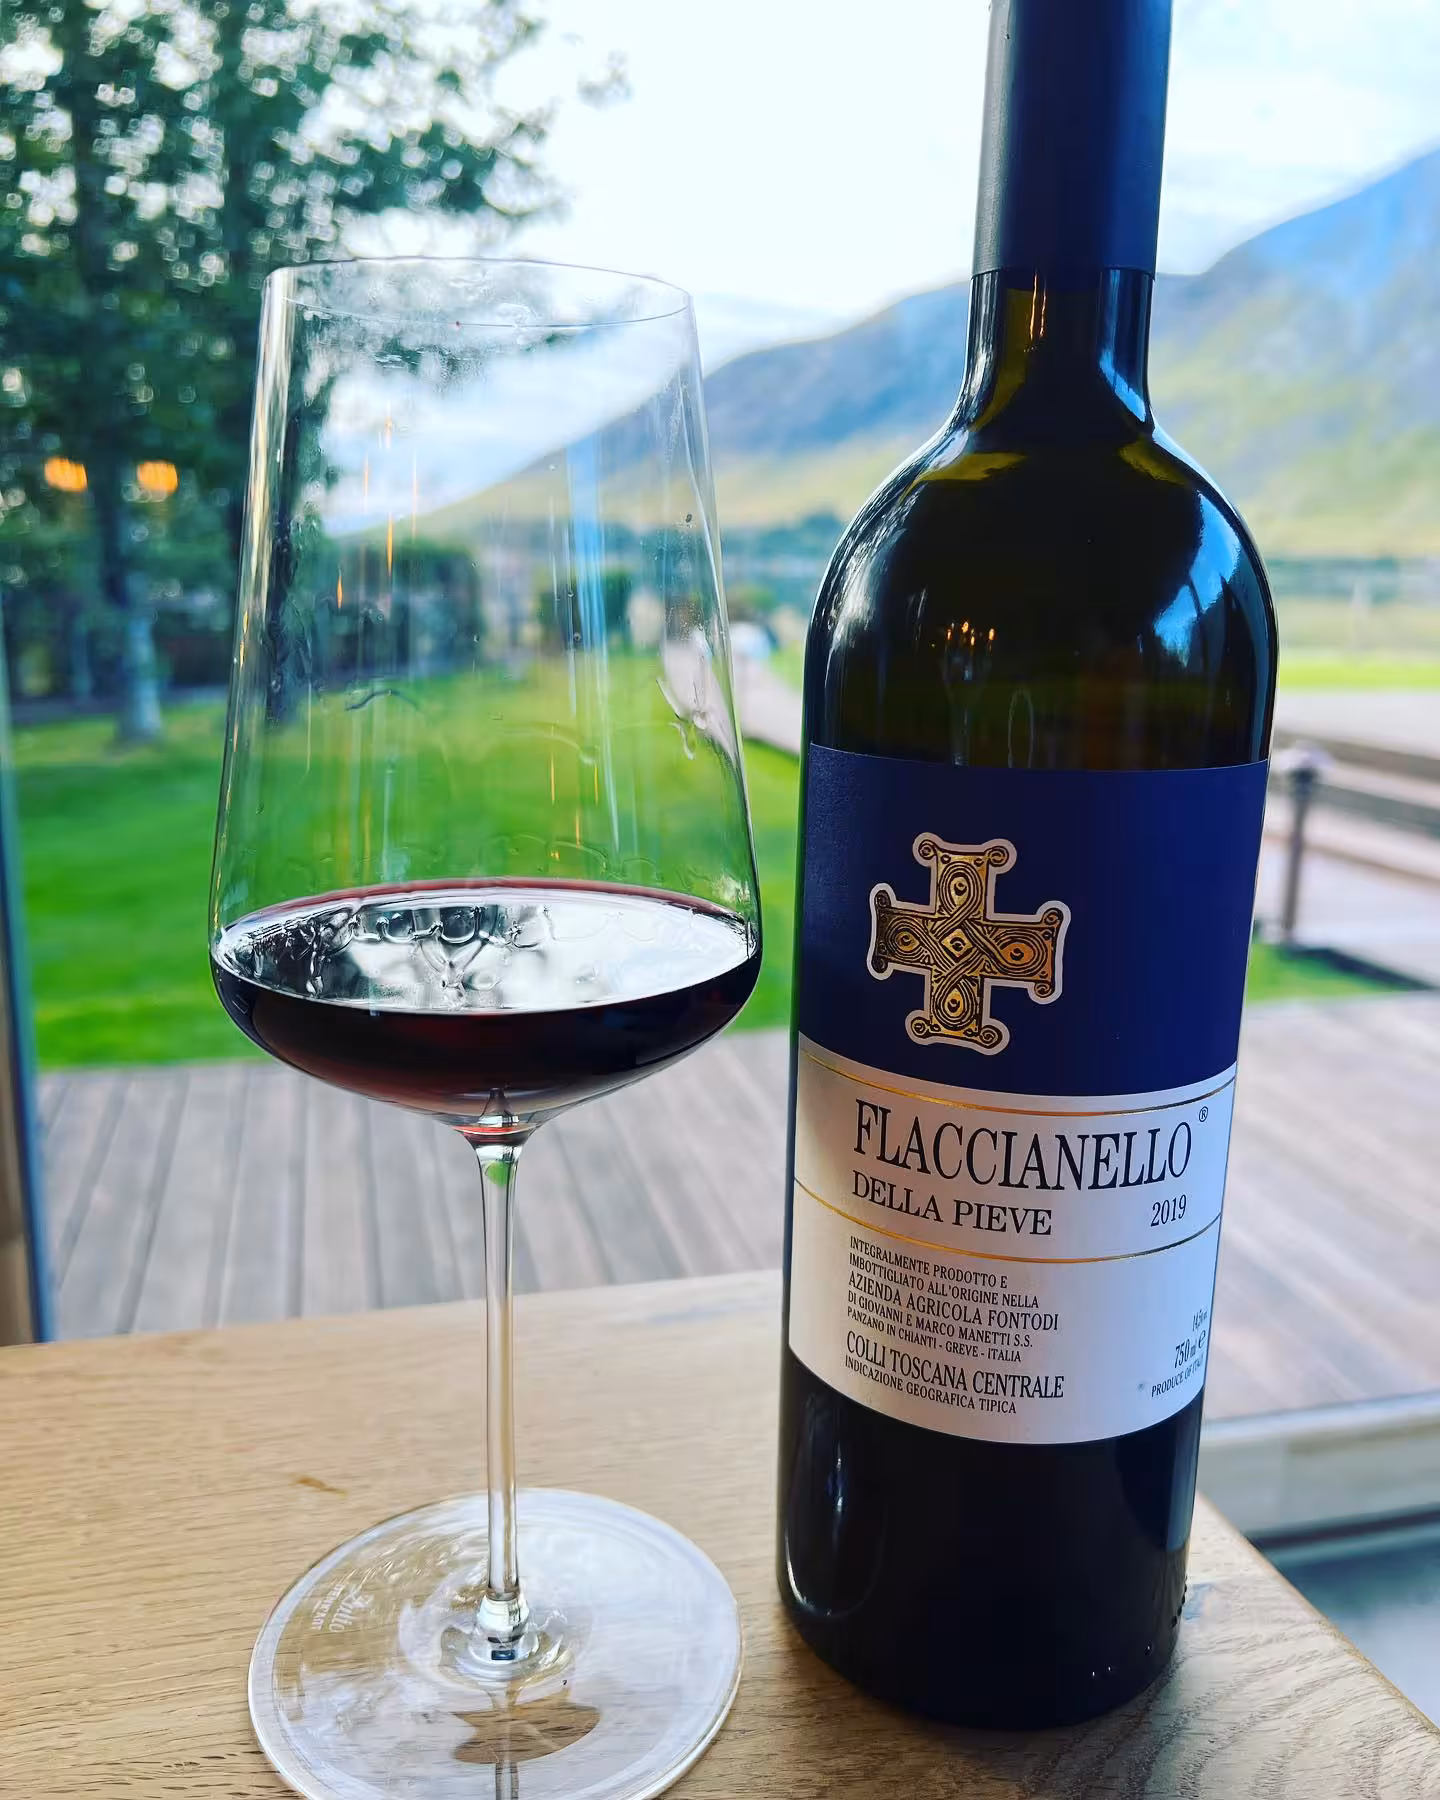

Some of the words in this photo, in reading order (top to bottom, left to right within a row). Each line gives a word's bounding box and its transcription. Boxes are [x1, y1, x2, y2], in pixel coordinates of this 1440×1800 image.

[854, 1099, 1192, 1191] FLACCIANELLO
[851, 1169, 942, 1222] DELLA
[952, 1199, 1052, 1236] PIEVE
[1150, 1194, 1187, 1228] 2019
[849, 1252, 925, 1291] IMBOTTIGLIATO
[927, 1281, 998, 1306] ALL'ORIGINE
[1002, 1293, 1039, 1309] NELLA
[850, 1236, 930, 1275] INTEGRALMENTE
[933, 1264, 997, 1287] PRODOTTO
[1000, 1275, 1008, 1289] E
[848, 1290, 857, 1306] DI
[858, 1295, 903, 1324] GIOVANNI
[906, 1314, 913, 1327] E
[916, 1317, 955, 1338] MARCO
[958, 1326, 1011, 1346] MANETTI
[1014, 1333, 1033, 1348] S.S.
[849, 1271, 902, 1306] AZIENDA
[906, 1293, 983, 1325] AGRICOLA
[988, 1310, 1059, 1331] FONTODI
[848, 1307, 885, 1332] PANZANO
[887, 1323, 896, 1335] IN
[898, 1327, 937, 1349] CHIANTI
[945, 1340, 979, 1358] GREVE
[987, 1348, 1022, 1363] ITALIA
[1174, 1338, 1190, 1369] 750
[845, 1355, 904, 1392] INDICAZIONE
[906, 1382, 976, 1410] GEOGRAFICA
[979, 1397, 1017, 1414] TIPICA
[847, 1331, 886, 1369] COLLI
[890, 1347, 968, 1391] TOSCANA
[972, 1370, 1065, 1399] CENTRALE
[1151, 1371, 1184, 1398] PRODUCE
